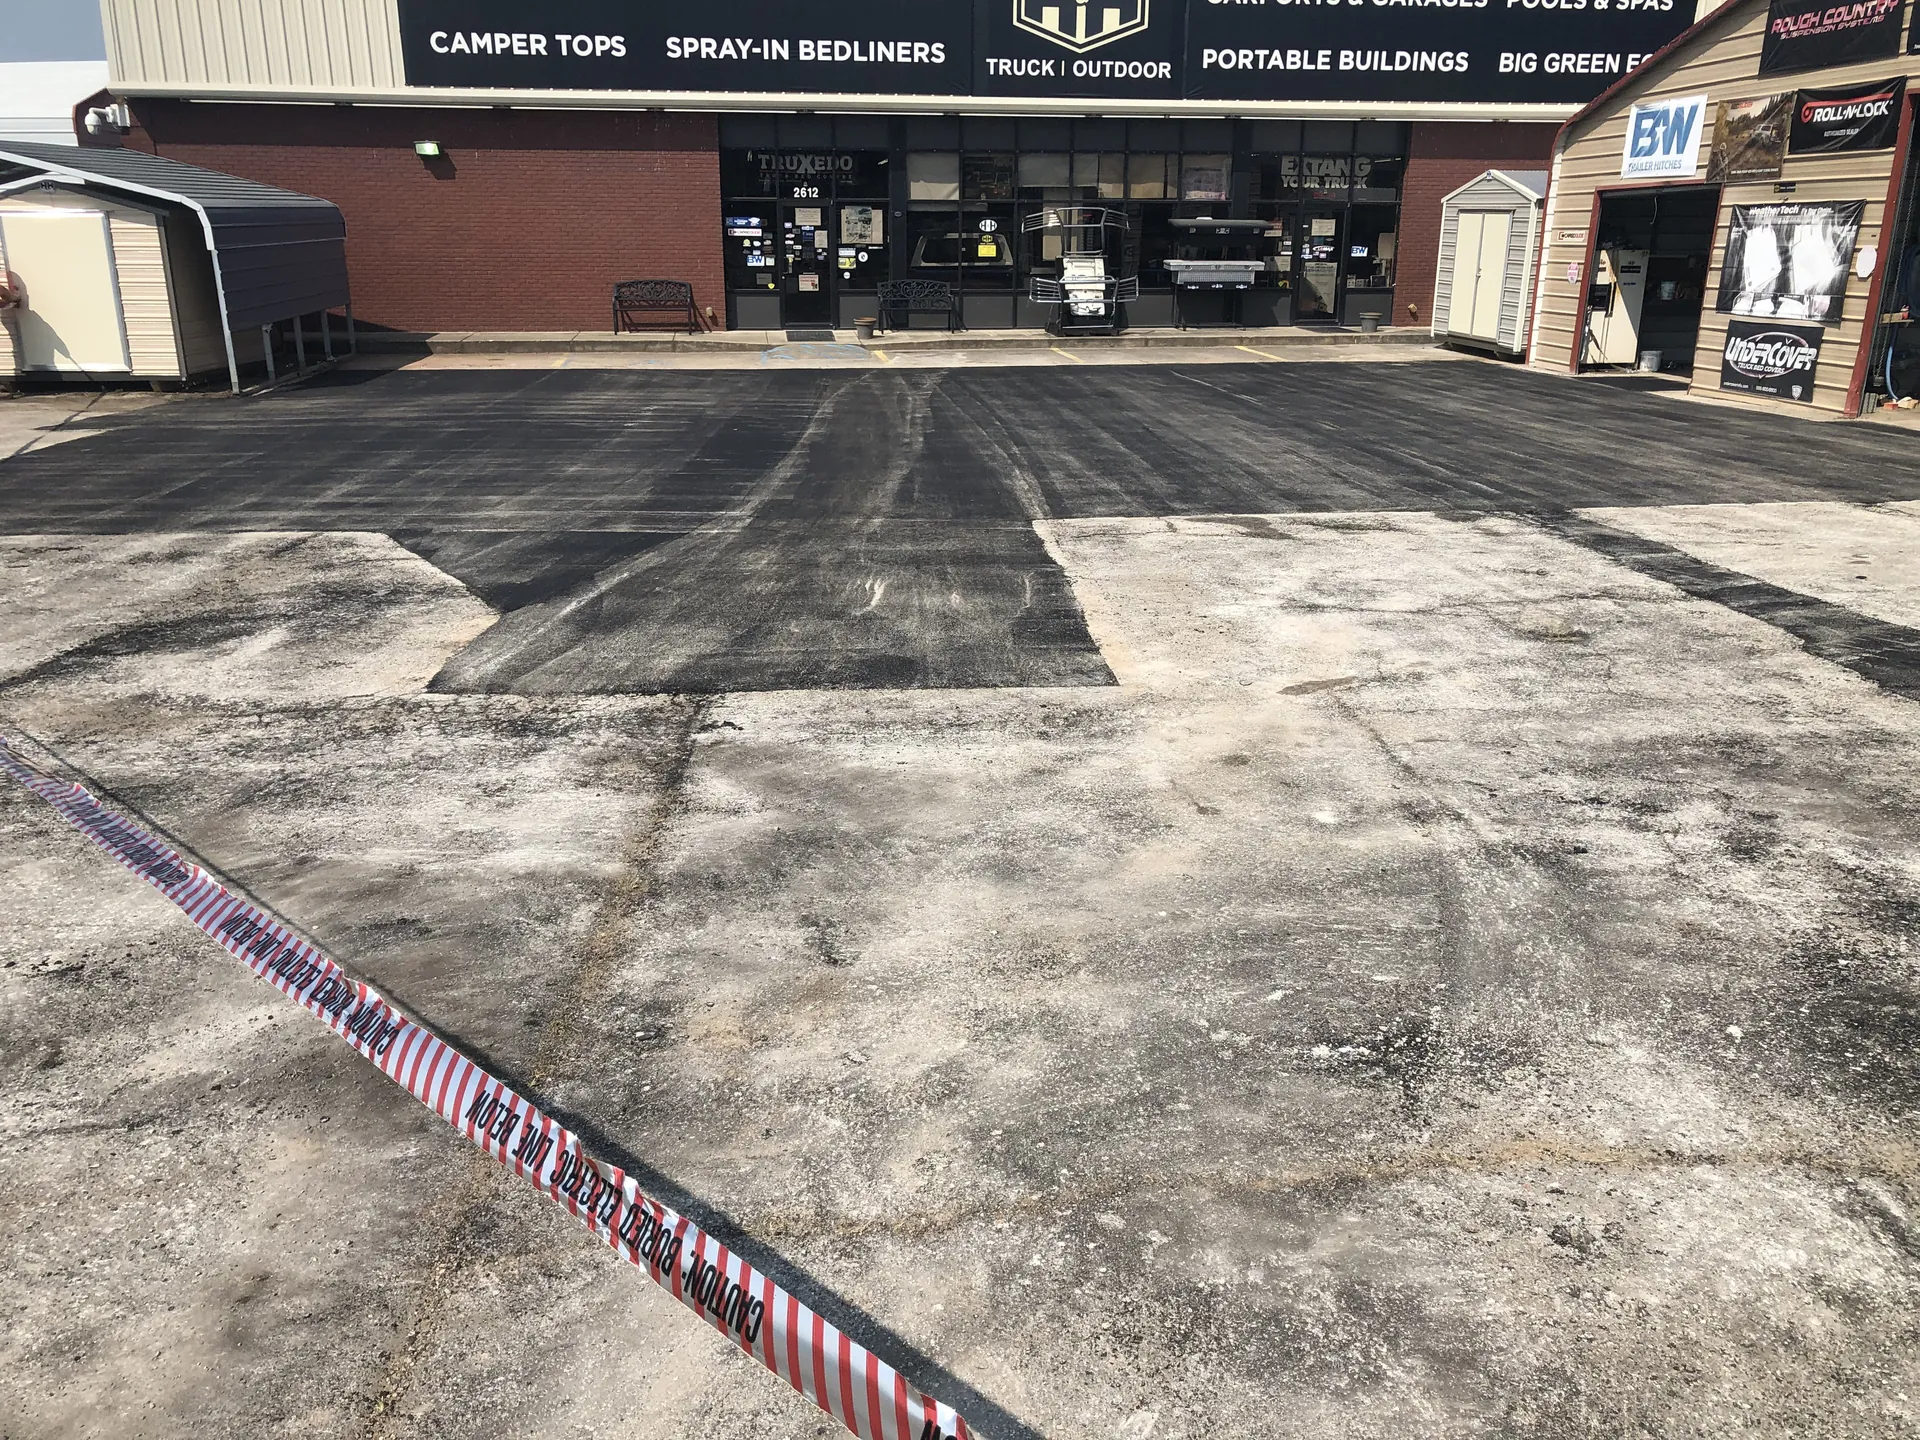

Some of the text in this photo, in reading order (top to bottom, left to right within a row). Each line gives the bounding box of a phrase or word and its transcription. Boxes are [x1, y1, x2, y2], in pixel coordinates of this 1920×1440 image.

[1771, 0, 1899, 34] ROUGH COUNTRY
[1780, 14, 1886, 40] SUSPENSION SYSTEMS
[429, 31, 627, 58] CAMPER TOPS
[666, 36, 946, 64] SPRAY-IN BEDLINERS
[986, 58, 1171, 79] TRUCK OUTDOOR
[1202, 49, 1469, 72] PORTABLE BUILDINGS
[1499, 52, 1538, 73] BIG
[1544, 53, 1620, 73] GREEN
[758, 154, 853, 174] TRUXEDO
[1281, 156, 1371, 176] EXTANG
[1654, 160, 1682, 170] HITCHES
[793, 187, 818, 198] 2612
[1281, 176, 1320, 188] YOUR
[1725, 337, 1818, 370] UNDERCOVER
[1738, 362, 1754, 370] TRUCK
[219, 913, 262, 946] BELOW
[247, 932, 282, 961] LINE
[268, 948, 322, 992] ELECTRIC
[465, 1090, 521, 1147] BELOW
[511, 1123, 555, 1172] LINE
[550, 1150, 623, 1226] ELECTRIC
[618, 1203, 682, 1277] BURIED
